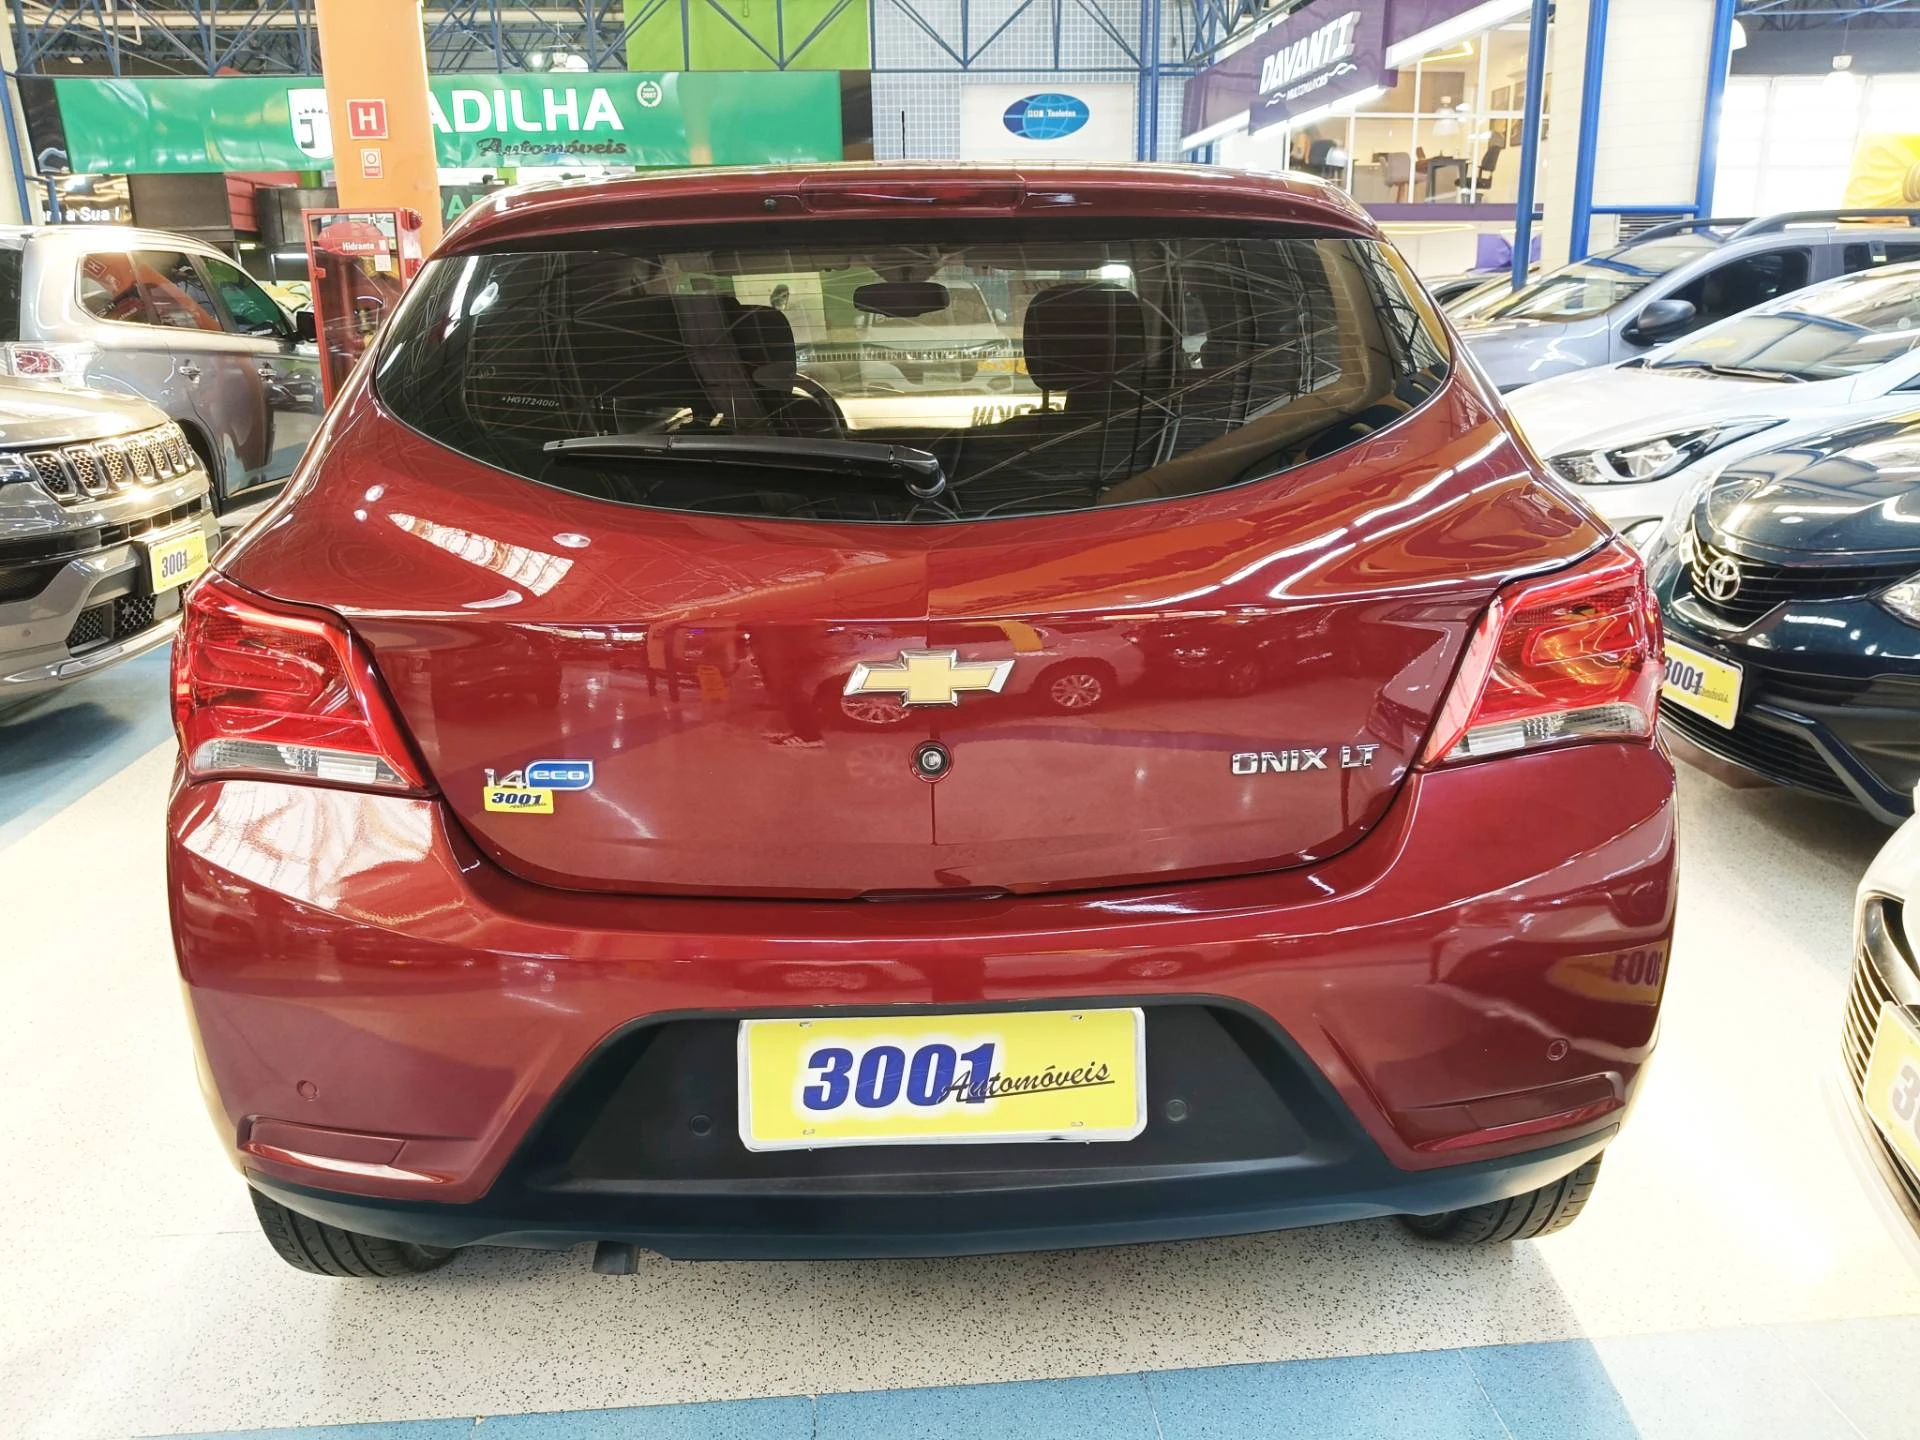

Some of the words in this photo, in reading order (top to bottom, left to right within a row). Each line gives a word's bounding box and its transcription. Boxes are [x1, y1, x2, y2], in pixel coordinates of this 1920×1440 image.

[1259, 11, 1361, 96] DAVANTI
[357, 106, 379, 131] H
[476, 137, 627, 157] Automóveis
[80, 206, 110, 221] Sua
[341, 241, 375, 251] Hidrante
[161, 549, 188, 578] 3001
[1340, 743, 1380, 769] LT
[491, 792, 543, 805] 3001
[802, 1042, 996, 1112] 3001
[937, 1060, 1115, 1104] Automóveis
